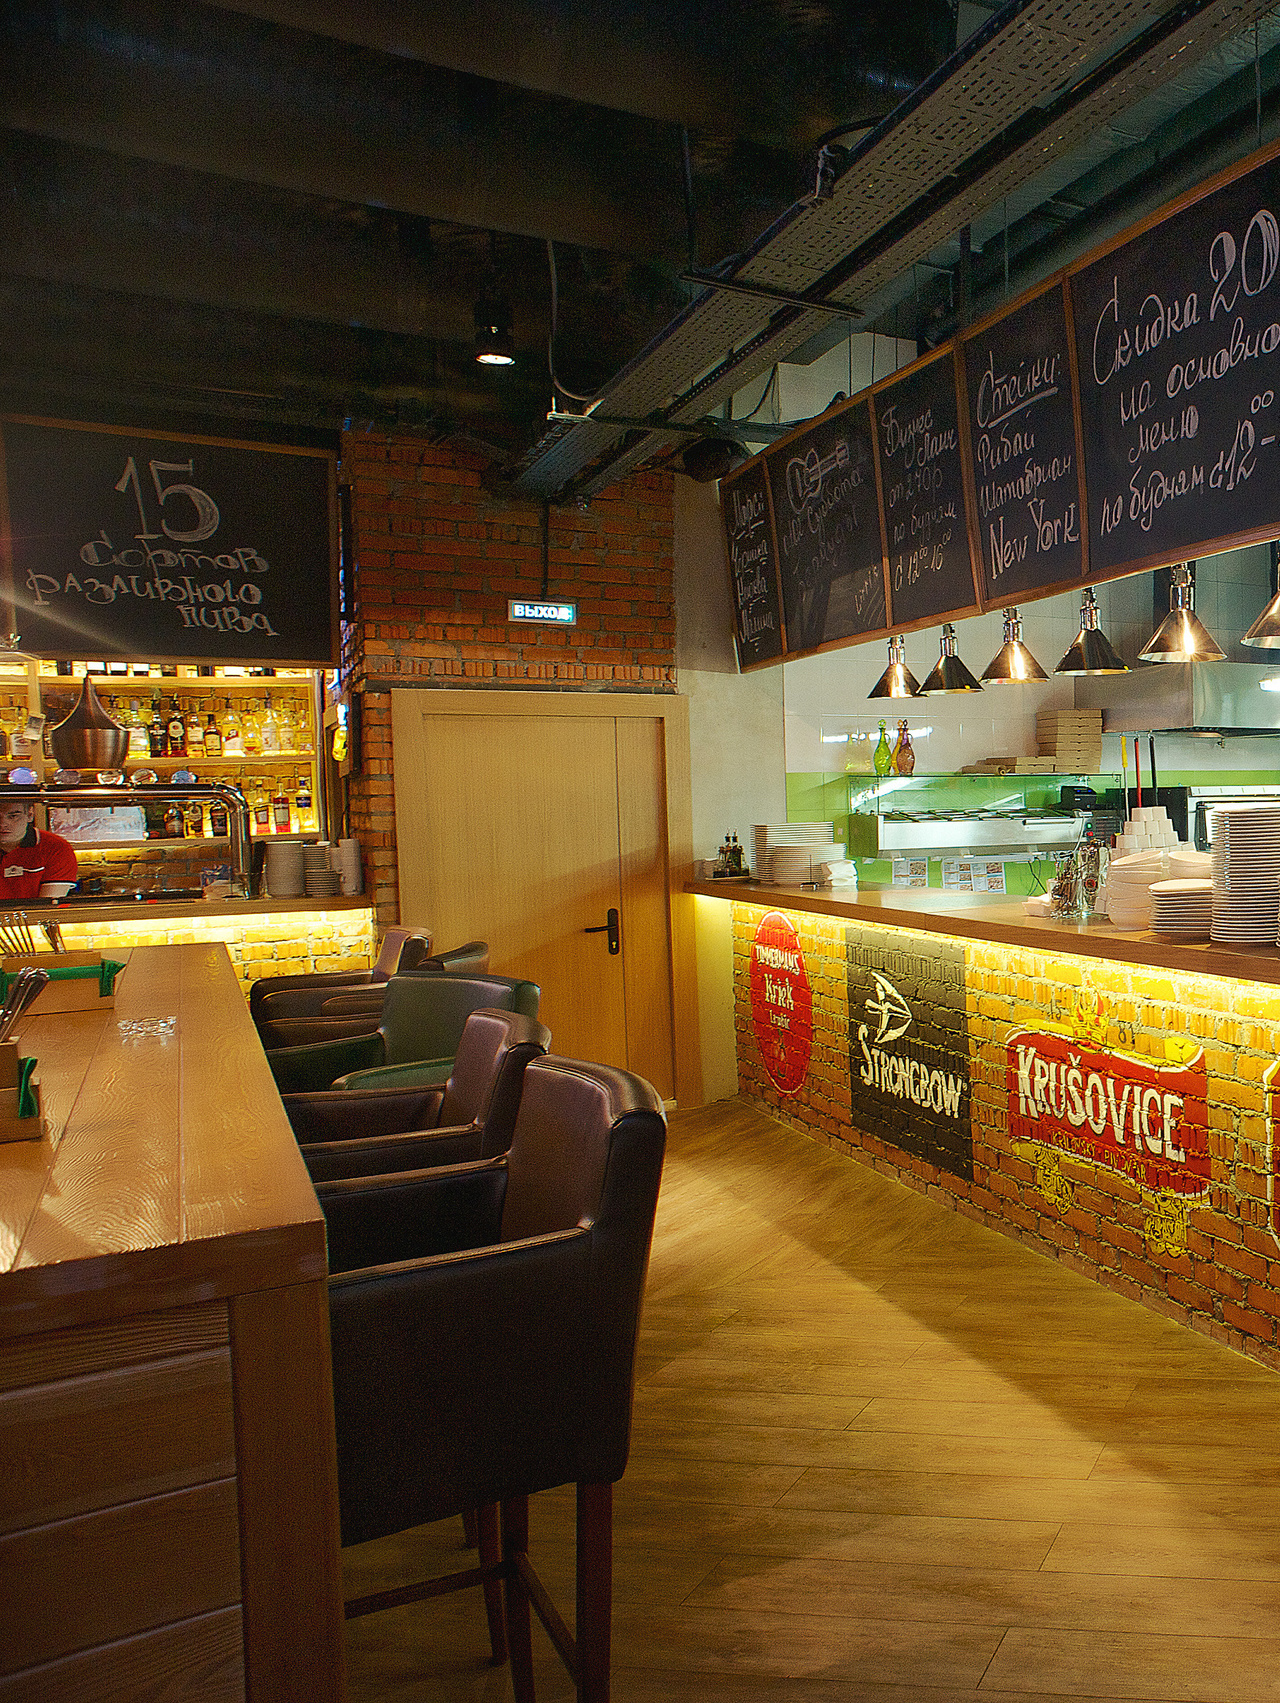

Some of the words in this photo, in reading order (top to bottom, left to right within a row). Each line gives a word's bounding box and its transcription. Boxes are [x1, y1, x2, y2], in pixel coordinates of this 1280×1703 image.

[1094, 276, 1201, 385] Скидка
[1120, 379, 1157, 427] на
[1129, 405, 1200, 464] меню
[978, 410, 1035, 476] Рибай
[115, 456, 220, 542] 15
[980, 454, 1072, 518] Шатобриан
[1101, 495, 1125, 537] по
[1129, 462, 1206, 532] будням
[990, 516, 1028, 580] New
[1028, 497, 1080, 553] York
[858, 1025, 962, 1119] STRONGBOW
[1016, 1045, 1186, 1163] KRUŠOVICE
